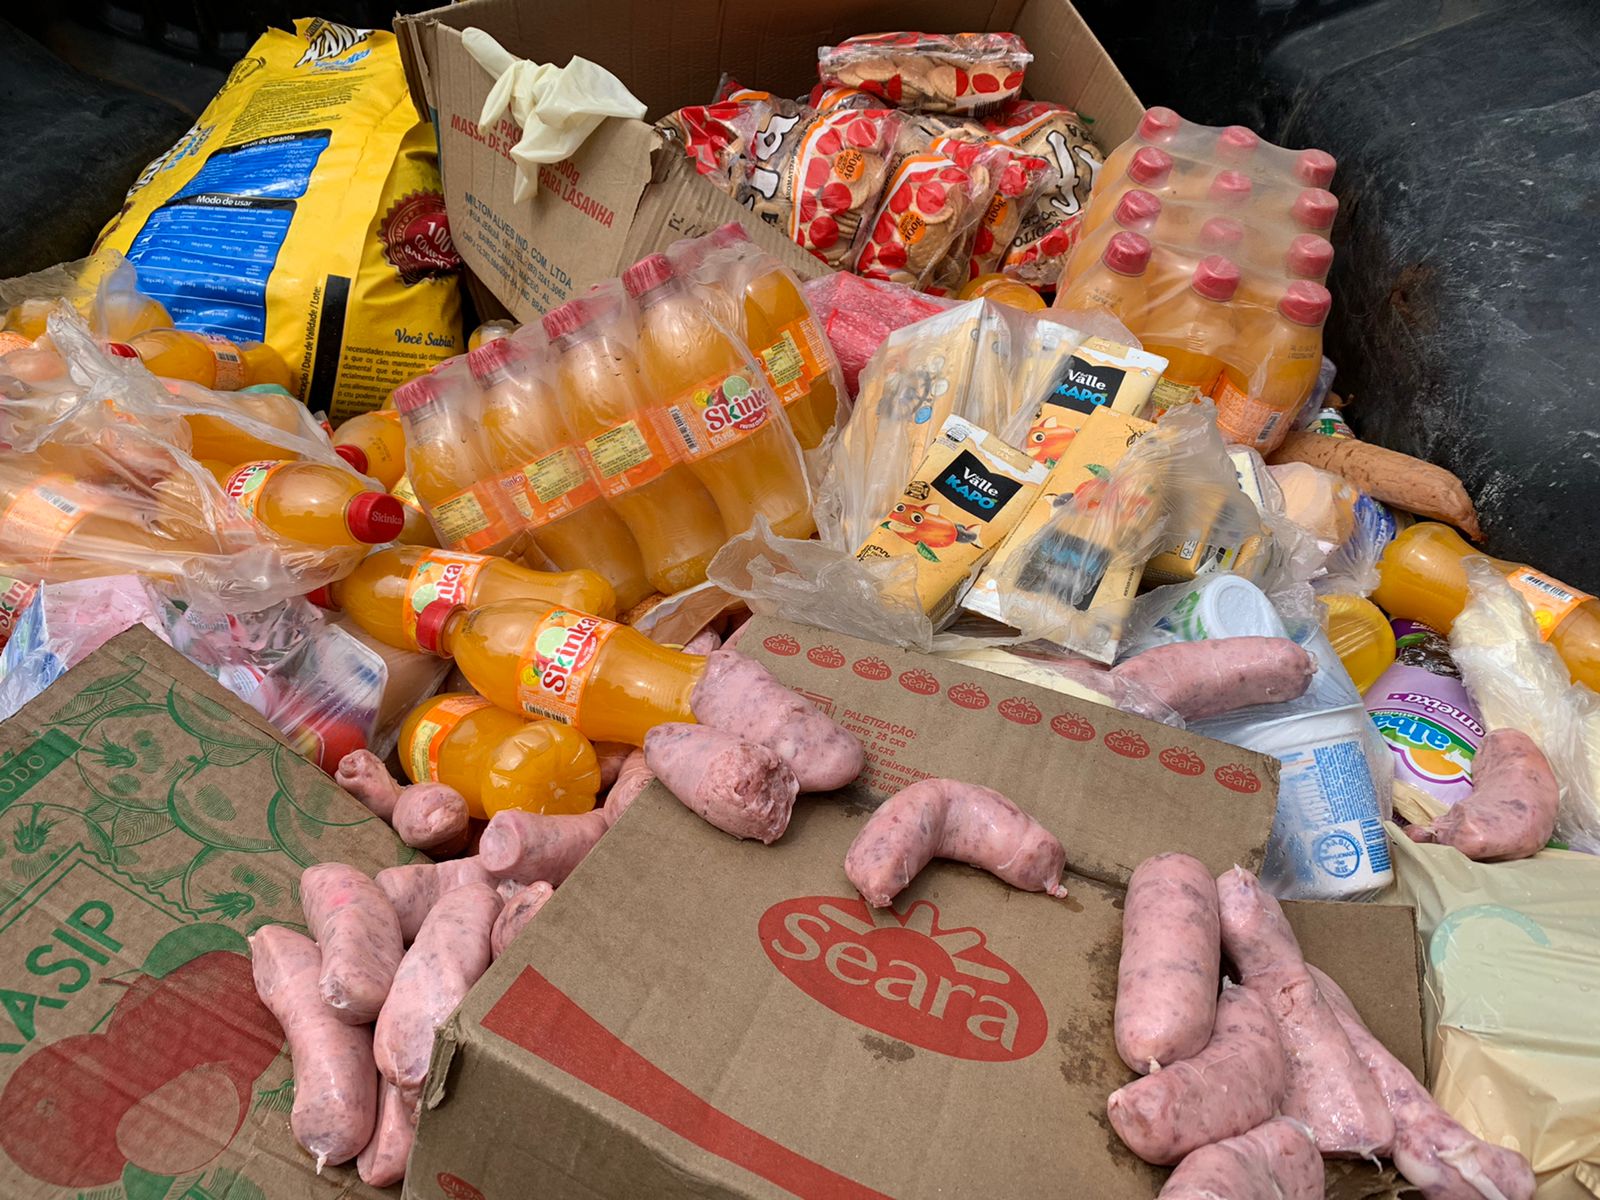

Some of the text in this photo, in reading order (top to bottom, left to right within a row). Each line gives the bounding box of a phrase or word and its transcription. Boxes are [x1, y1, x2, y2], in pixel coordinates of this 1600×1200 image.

[844, 151, 863, 180] 400g
[196, 195, 253, 207] Modo de usar
[539, 167, 615, 228] PARA LASANHA
[988, 199, 1006, 225] 400g
[903, 215, 924, 242] 400g
[492, 213, 516, 241] ALVES
[550, 264, 574, 291] LTDA.
[305, 309, 318, 341] Validade
[314, 286, 322, 306] Lote:
[395, 328, 423, 345] Você
[351, 356, 364, 364] que
[376, 356, 390, 366] cães
[391, 360, 426, 369] mantenham
[384, 349, 418, 359] nutricionais
[418, 352, 428, 361] são
[391, 367, 404, 376] eles
[351, 382, 382, 393] alimentos
[355, 392, 378, 403] podem
[371, 510, 403, 525] Skinka
[541, 616, 601, 695] Skinka
[1404, 692, 1487, 739] ameixa
[843, 709, 917, 740] PALETIZAÇÃO:
[874, 732, 888, 744] 25
[888, 738, 907, 749] cxs
[877, 745, 897, 758] cxs
